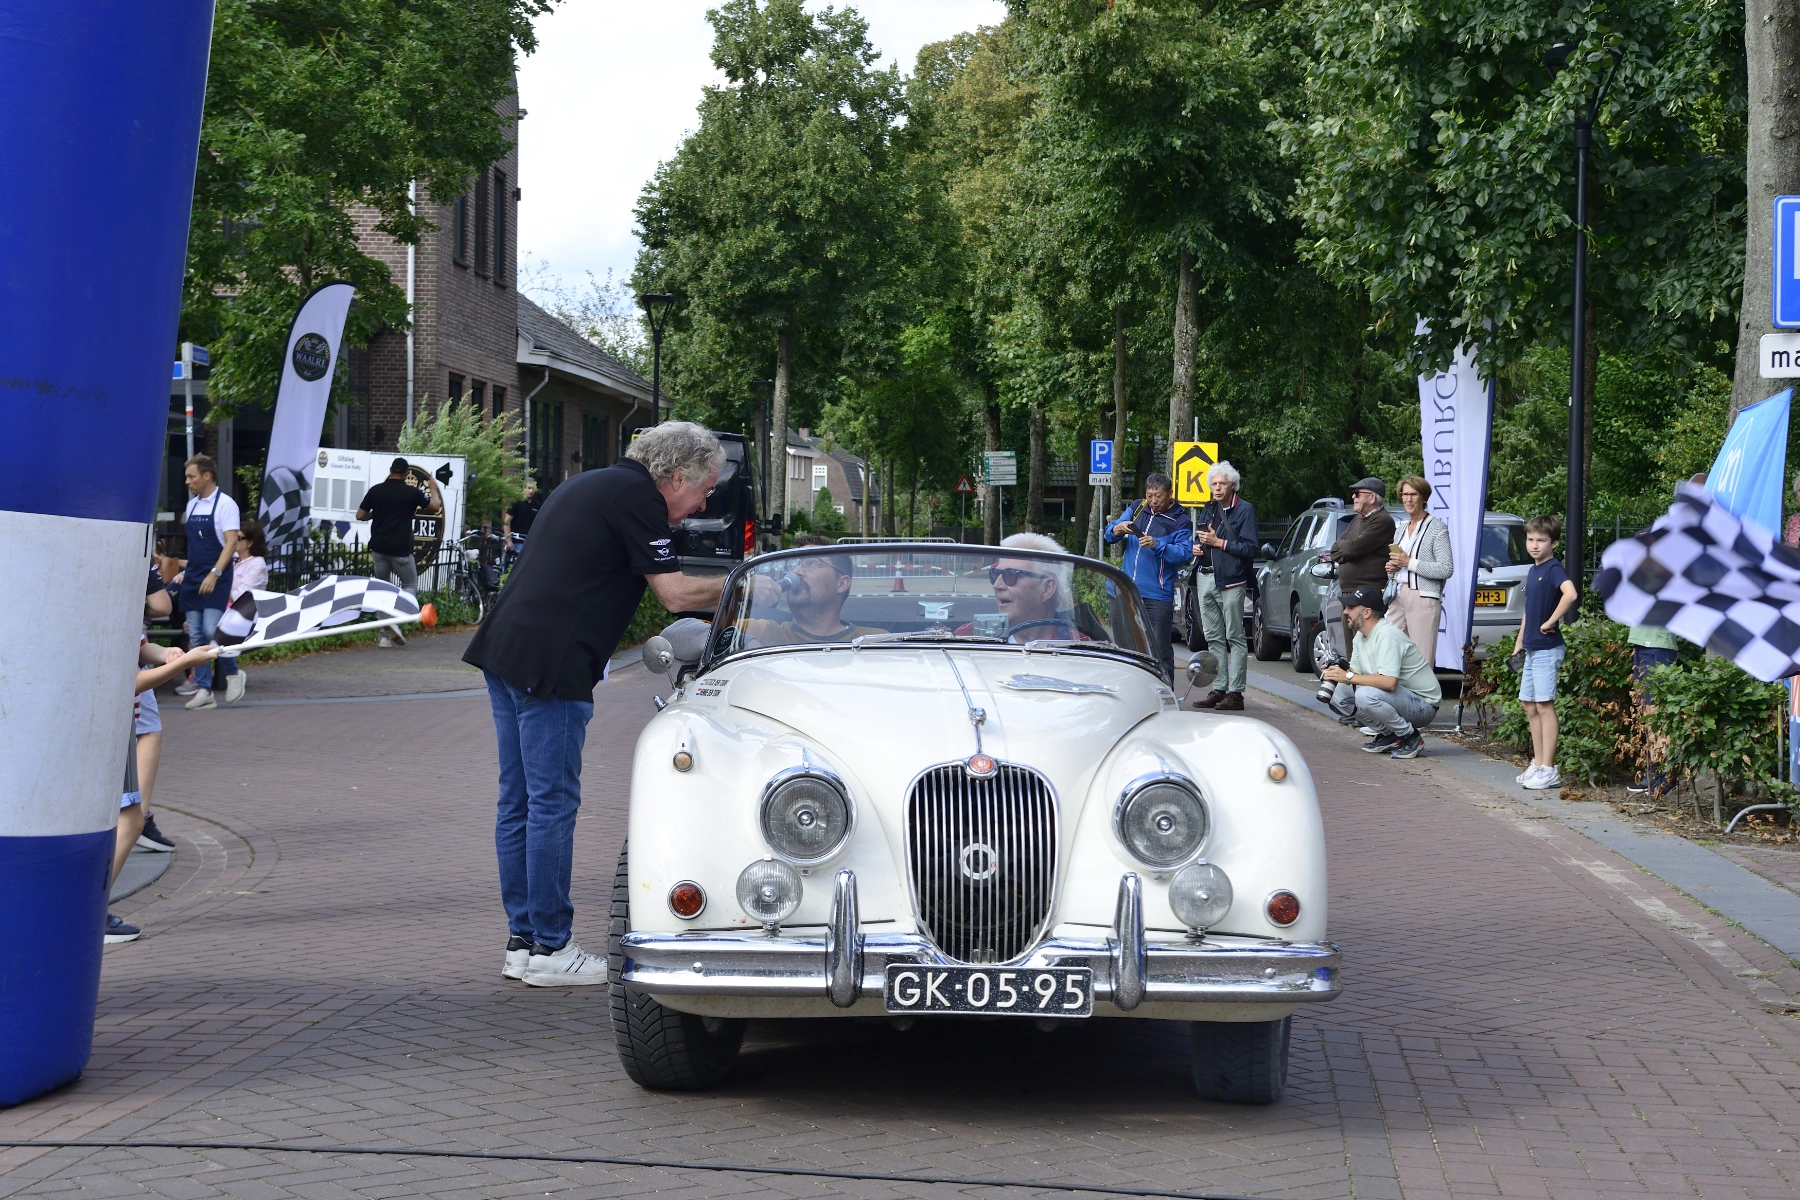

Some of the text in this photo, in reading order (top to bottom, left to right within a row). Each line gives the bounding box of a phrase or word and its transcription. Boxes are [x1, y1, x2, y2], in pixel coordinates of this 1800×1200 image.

[296, 352, 326, 366] WAALRE
[1095, 443, 1109, 461] P
[1186, 470, 1205, 493] K
[411, 518, 436, 537] LRE
[1475, 591, 1501, 602] PH-3
